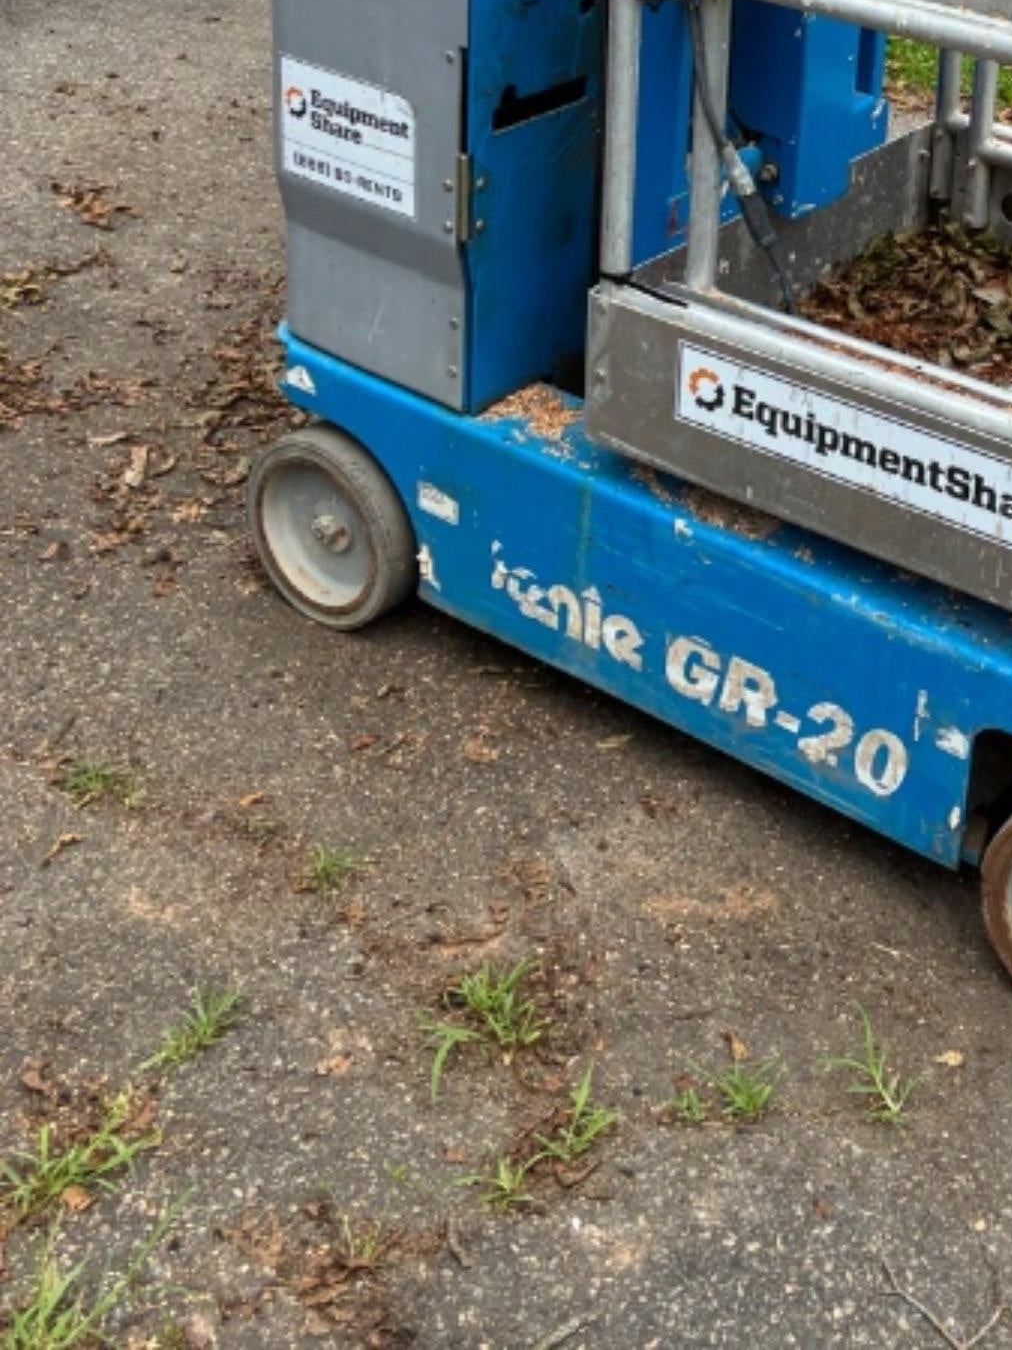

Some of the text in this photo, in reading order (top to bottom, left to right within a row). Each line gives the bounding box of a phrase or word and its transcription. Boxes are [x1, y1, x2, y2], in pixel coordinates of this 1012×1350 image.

[310, 89, 409, 139] Equipment
[311, 111, 362, 145] Share
[665, 634, 908, 796] GR-20
